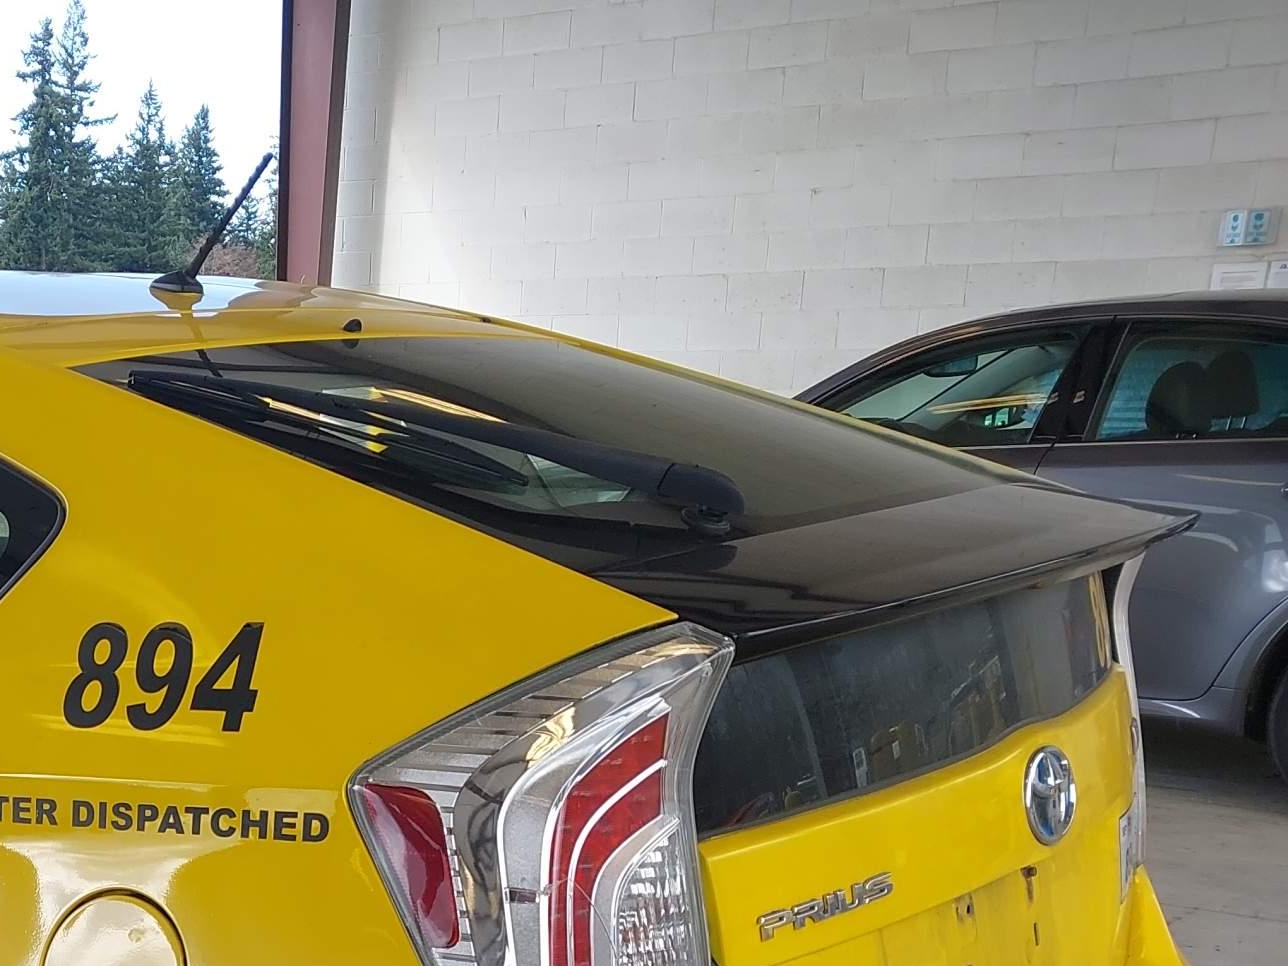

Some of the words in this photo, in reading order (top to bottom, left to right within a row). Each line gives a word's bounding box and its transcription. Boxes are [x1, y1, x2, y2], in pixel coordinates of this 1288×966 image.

[63, 622, 264, 732] 894
[71, 799, 330, 843] DISPATCHED
[756, 871, 894, 943] PRIUS
